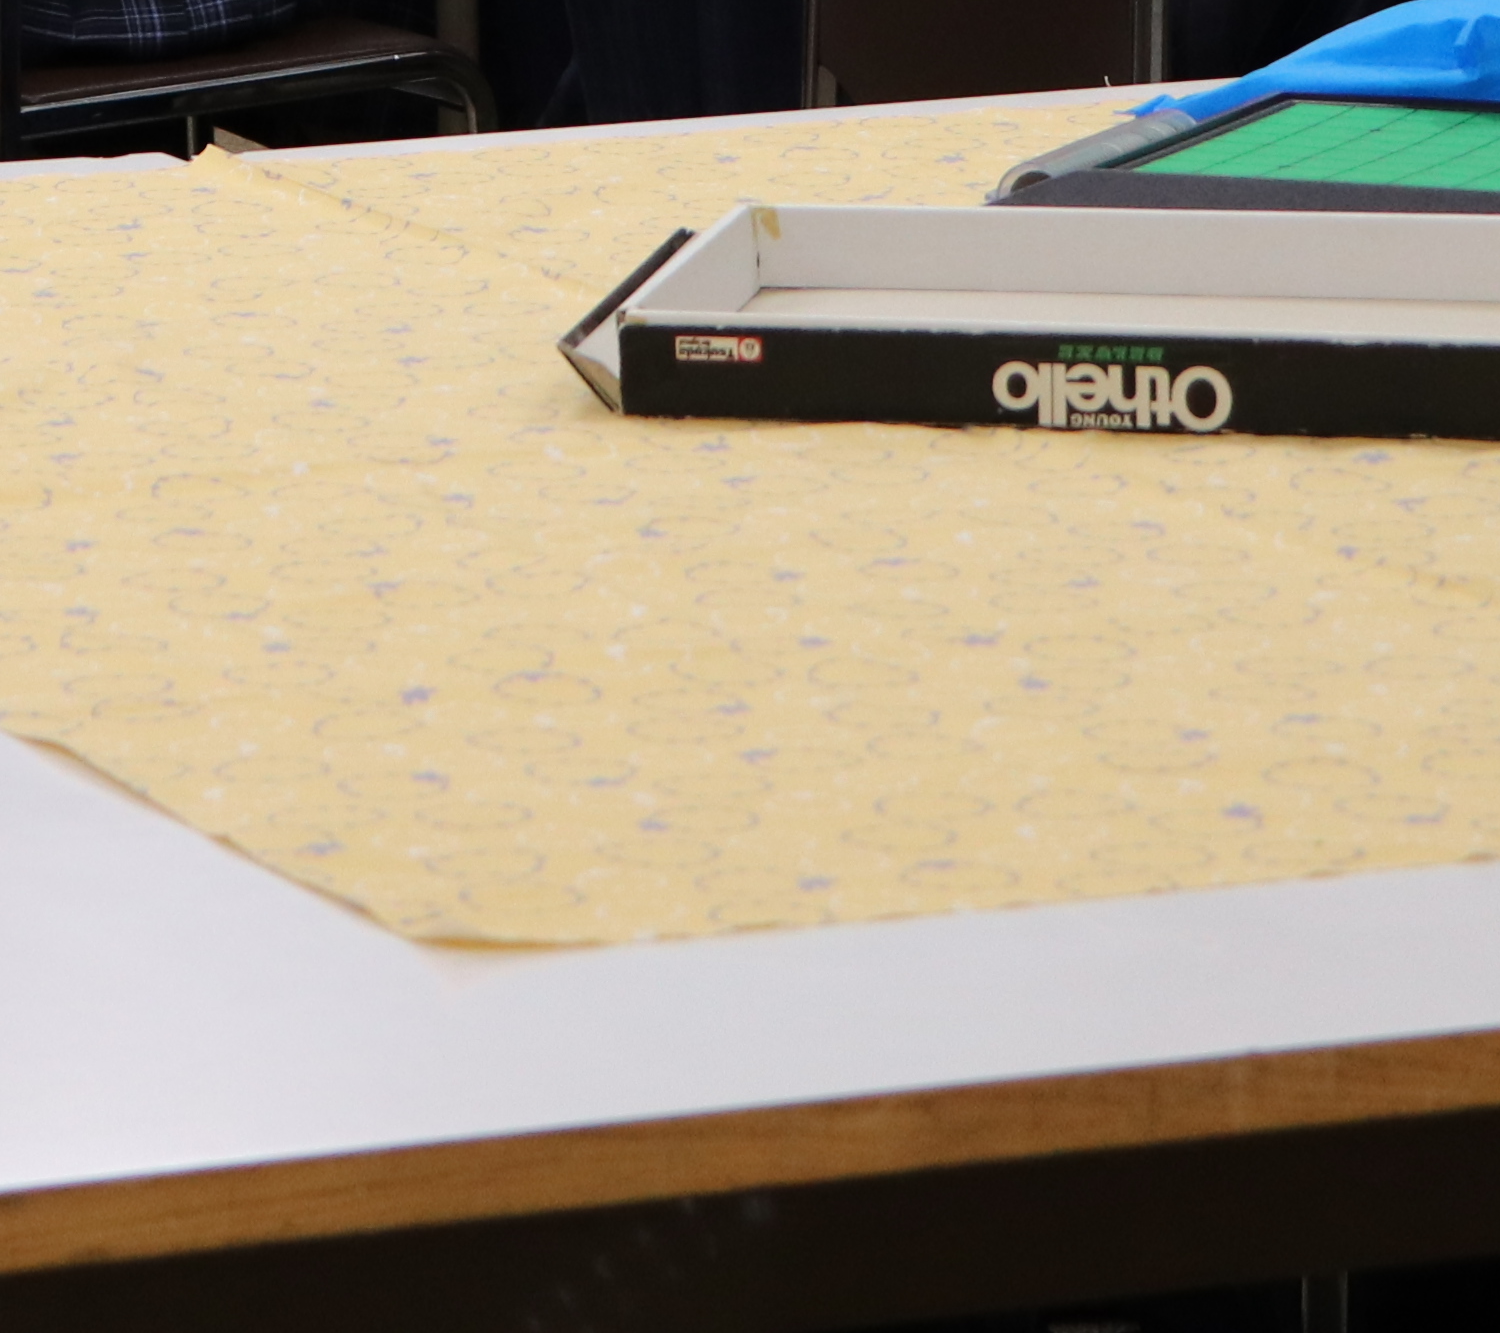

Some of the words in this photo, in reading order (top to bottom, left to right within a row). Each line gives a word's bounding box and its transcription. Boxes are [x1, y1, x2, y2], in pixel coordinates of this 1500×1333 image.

[1058, 344, 1165, 364] DELUXE
[992, 360, 1233, 432] Othello
[1070, 412, 1135, 429] YOUNG
